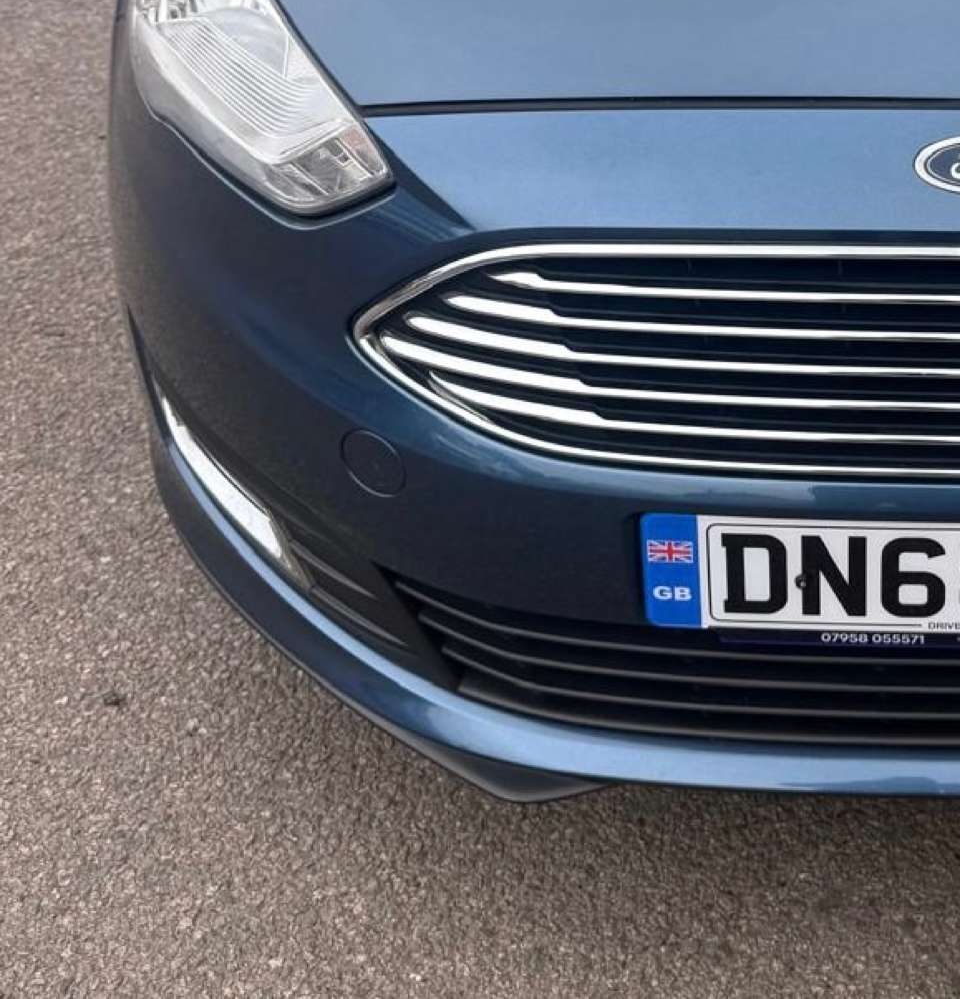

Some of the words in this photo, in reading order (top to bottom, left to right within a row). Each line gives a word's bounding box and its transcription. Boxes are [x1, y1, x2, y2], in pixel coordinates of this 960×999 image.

[653, 585, 692, 602] GB
[927, 621, 960, 630] DRIVE
[821, 632, 868, 644] 07958
[871, 633, 925, 645] 055571
